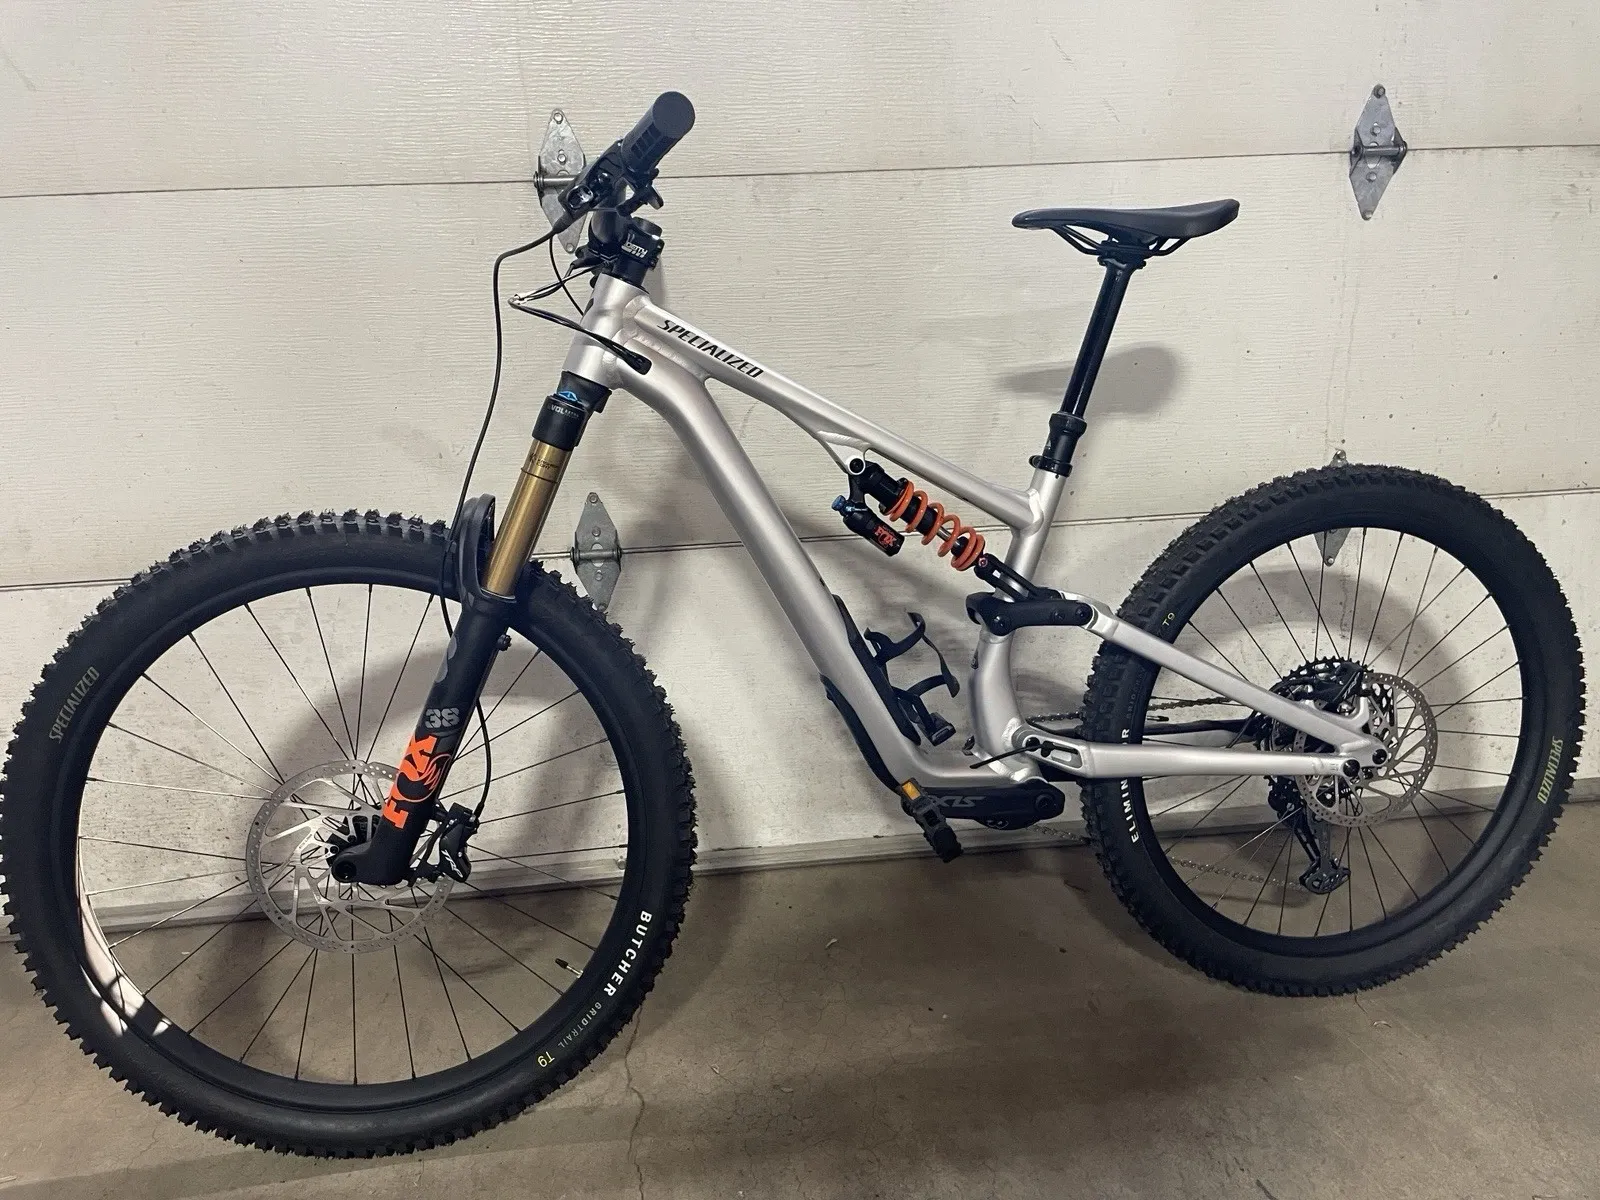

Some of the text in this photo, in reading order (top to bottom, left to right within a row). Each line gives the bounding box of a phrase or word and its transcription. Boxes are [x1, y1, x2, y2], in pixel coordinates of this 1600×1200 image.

[657, 319, 764, 379] SPECIALIZED
[874, 526, 897, 548] FOX
[1162, 612, 1175, 627] T9
[48, 666, 100, 744] SPECIALIZED
[382, 732, 452, 829] FOX
[1120, 728, 1140, 843] ELIMINR
[1537, 736, 1564, 804] SPECIALIZED
[603, 910, 652, 997] BUTCHER
[537, 1051, 555, 1068] T9
